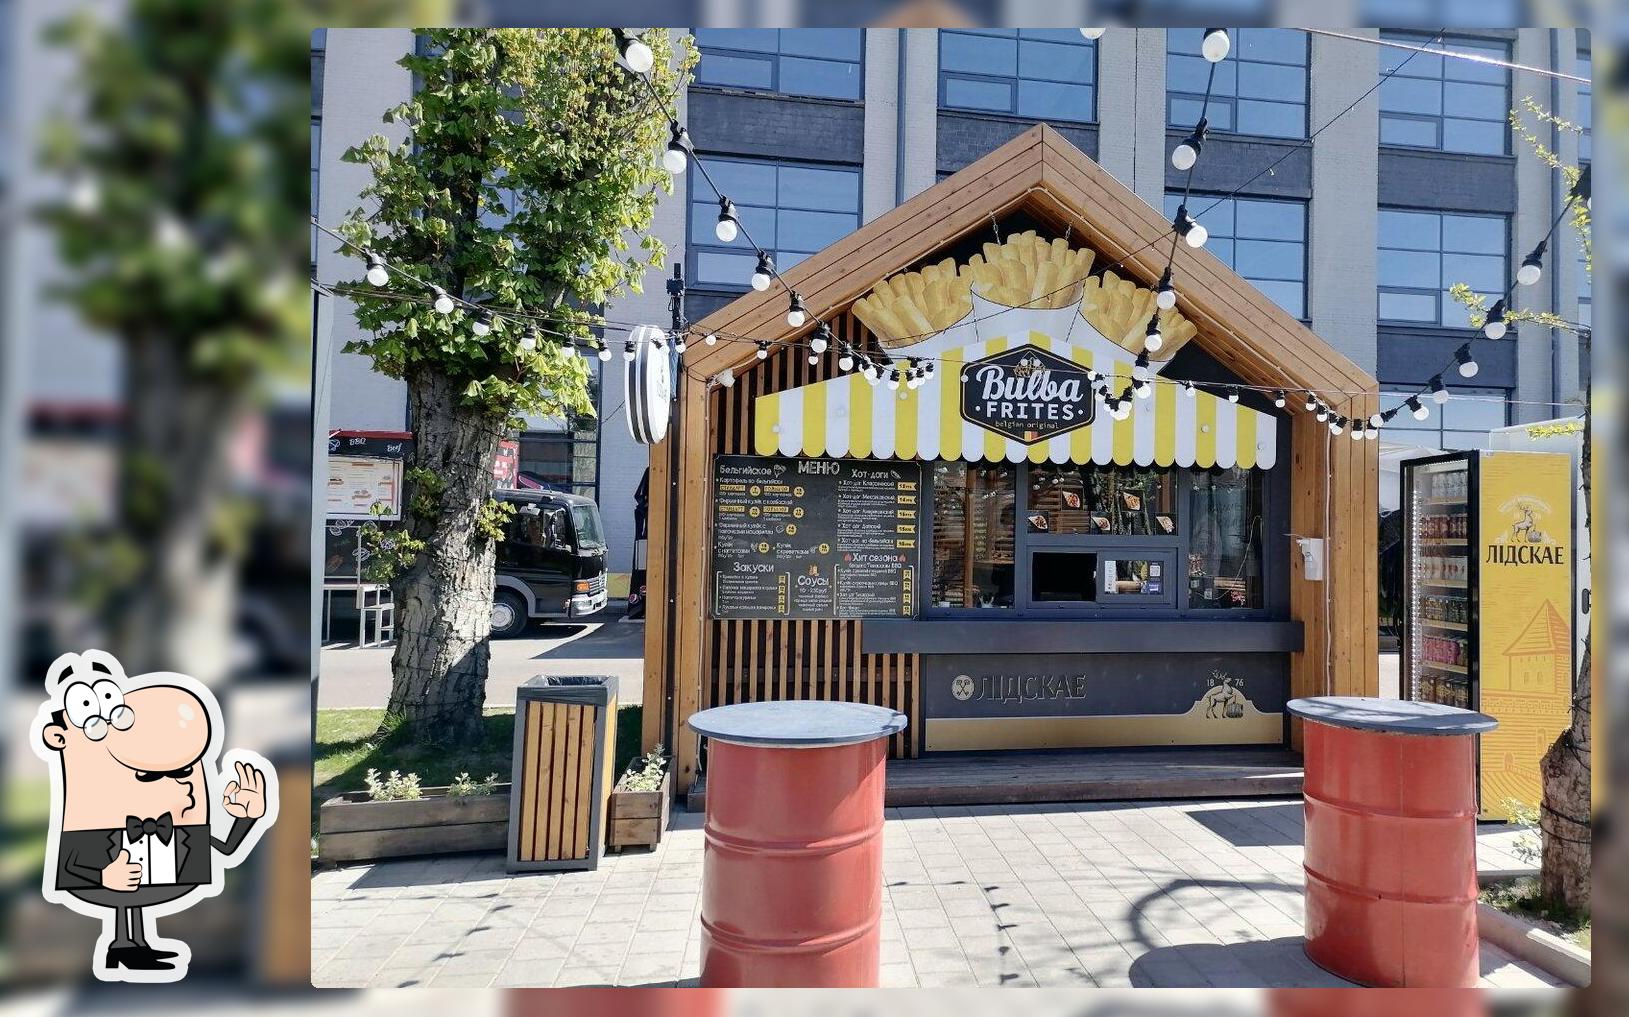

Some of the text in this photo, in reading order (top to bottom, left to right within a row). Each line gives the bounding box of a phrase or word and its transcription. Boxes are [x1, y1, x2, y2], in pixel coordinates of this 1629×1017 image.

[975, 365, 1084, 402] Bulba
[986, 401, 1074, 420] FRITES
[995, 420, 1024, 429] belgian
[719, 464, 772, 475] Бельгийское
[798, 461, 840, 474] МЕНЮ
[853, 553, 868, 562] Хит
[1486, 545, 1564, 567] ЛІДСКАЕ
[733, 561, 775, 574] Закуски
[797, 575, 829, 587] Соусы
[974, 672, 1087, 705] ЛІДСКАЕ
[1206, 678, 1244, 687] 18 76
